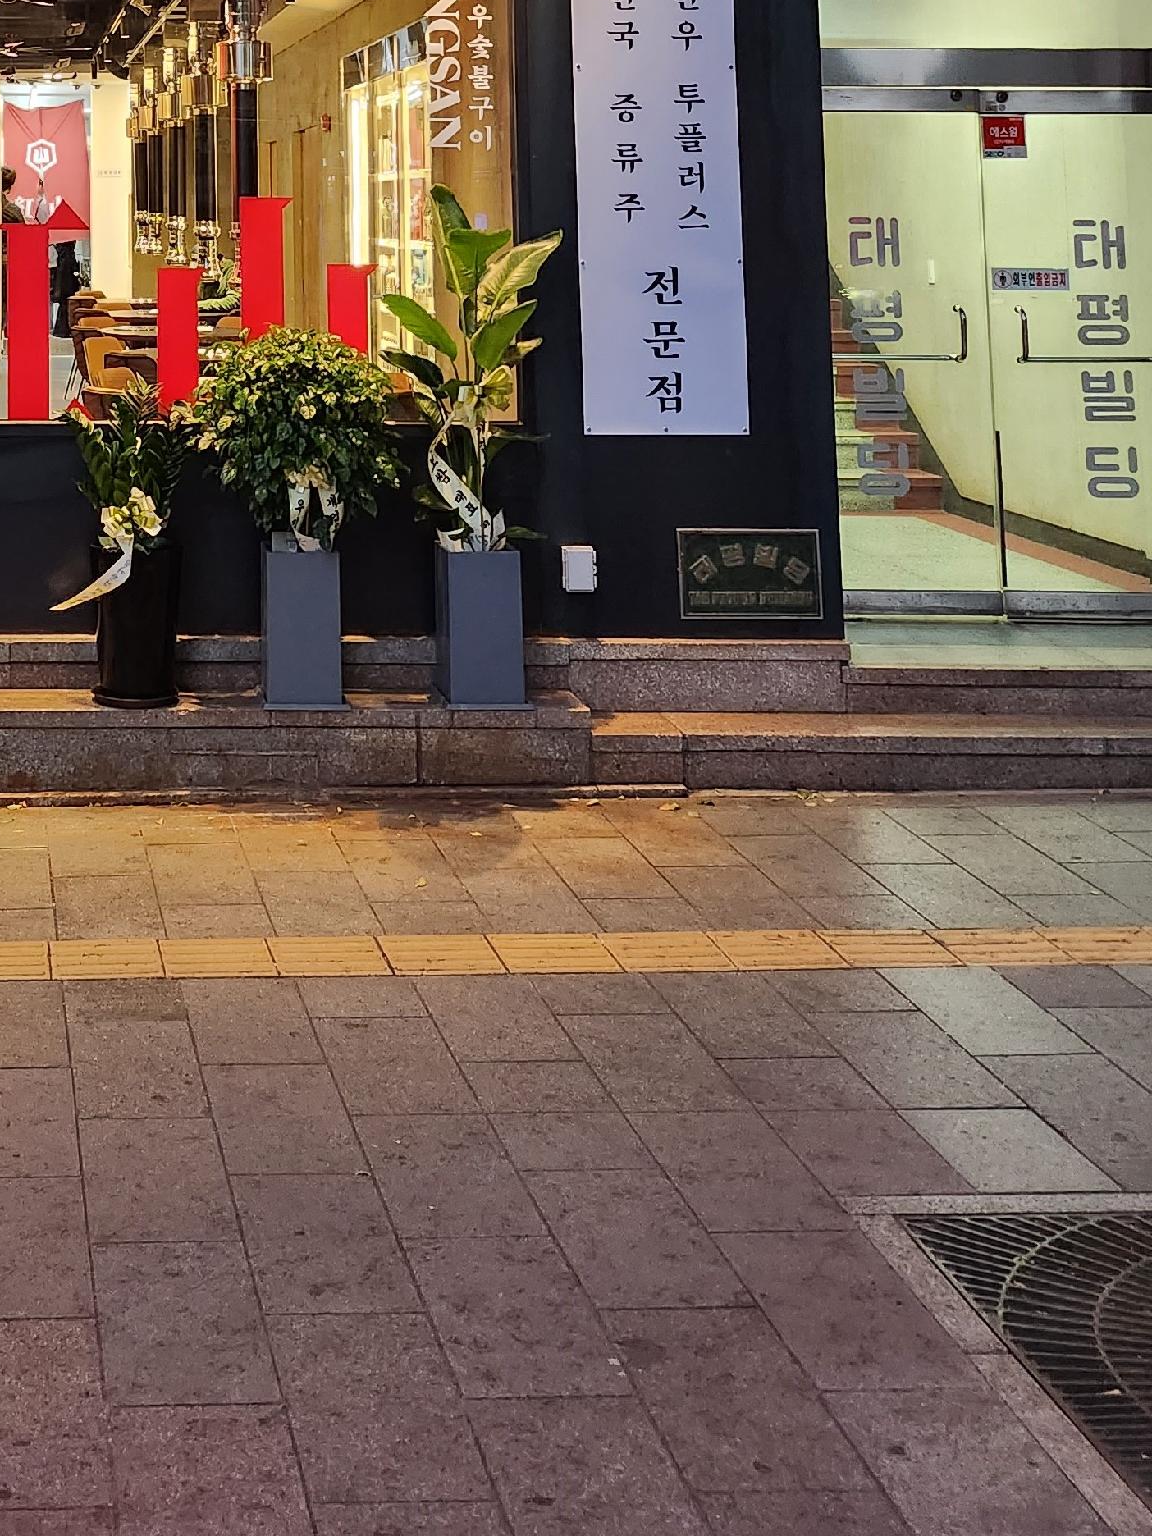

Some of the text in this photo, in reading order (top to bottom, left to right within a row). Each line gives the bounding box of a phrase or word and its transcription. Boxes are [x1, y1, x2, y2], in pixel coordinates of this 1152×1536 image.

[609, 93, 646, 224] 증류주
[673, 83, 710, 230] 투플러스
[641, 265, 686, 414] 전문점
[848, 217, 911, 497] 태평빌딩
[1072, 219, 1140, 498] 태평빌딩
